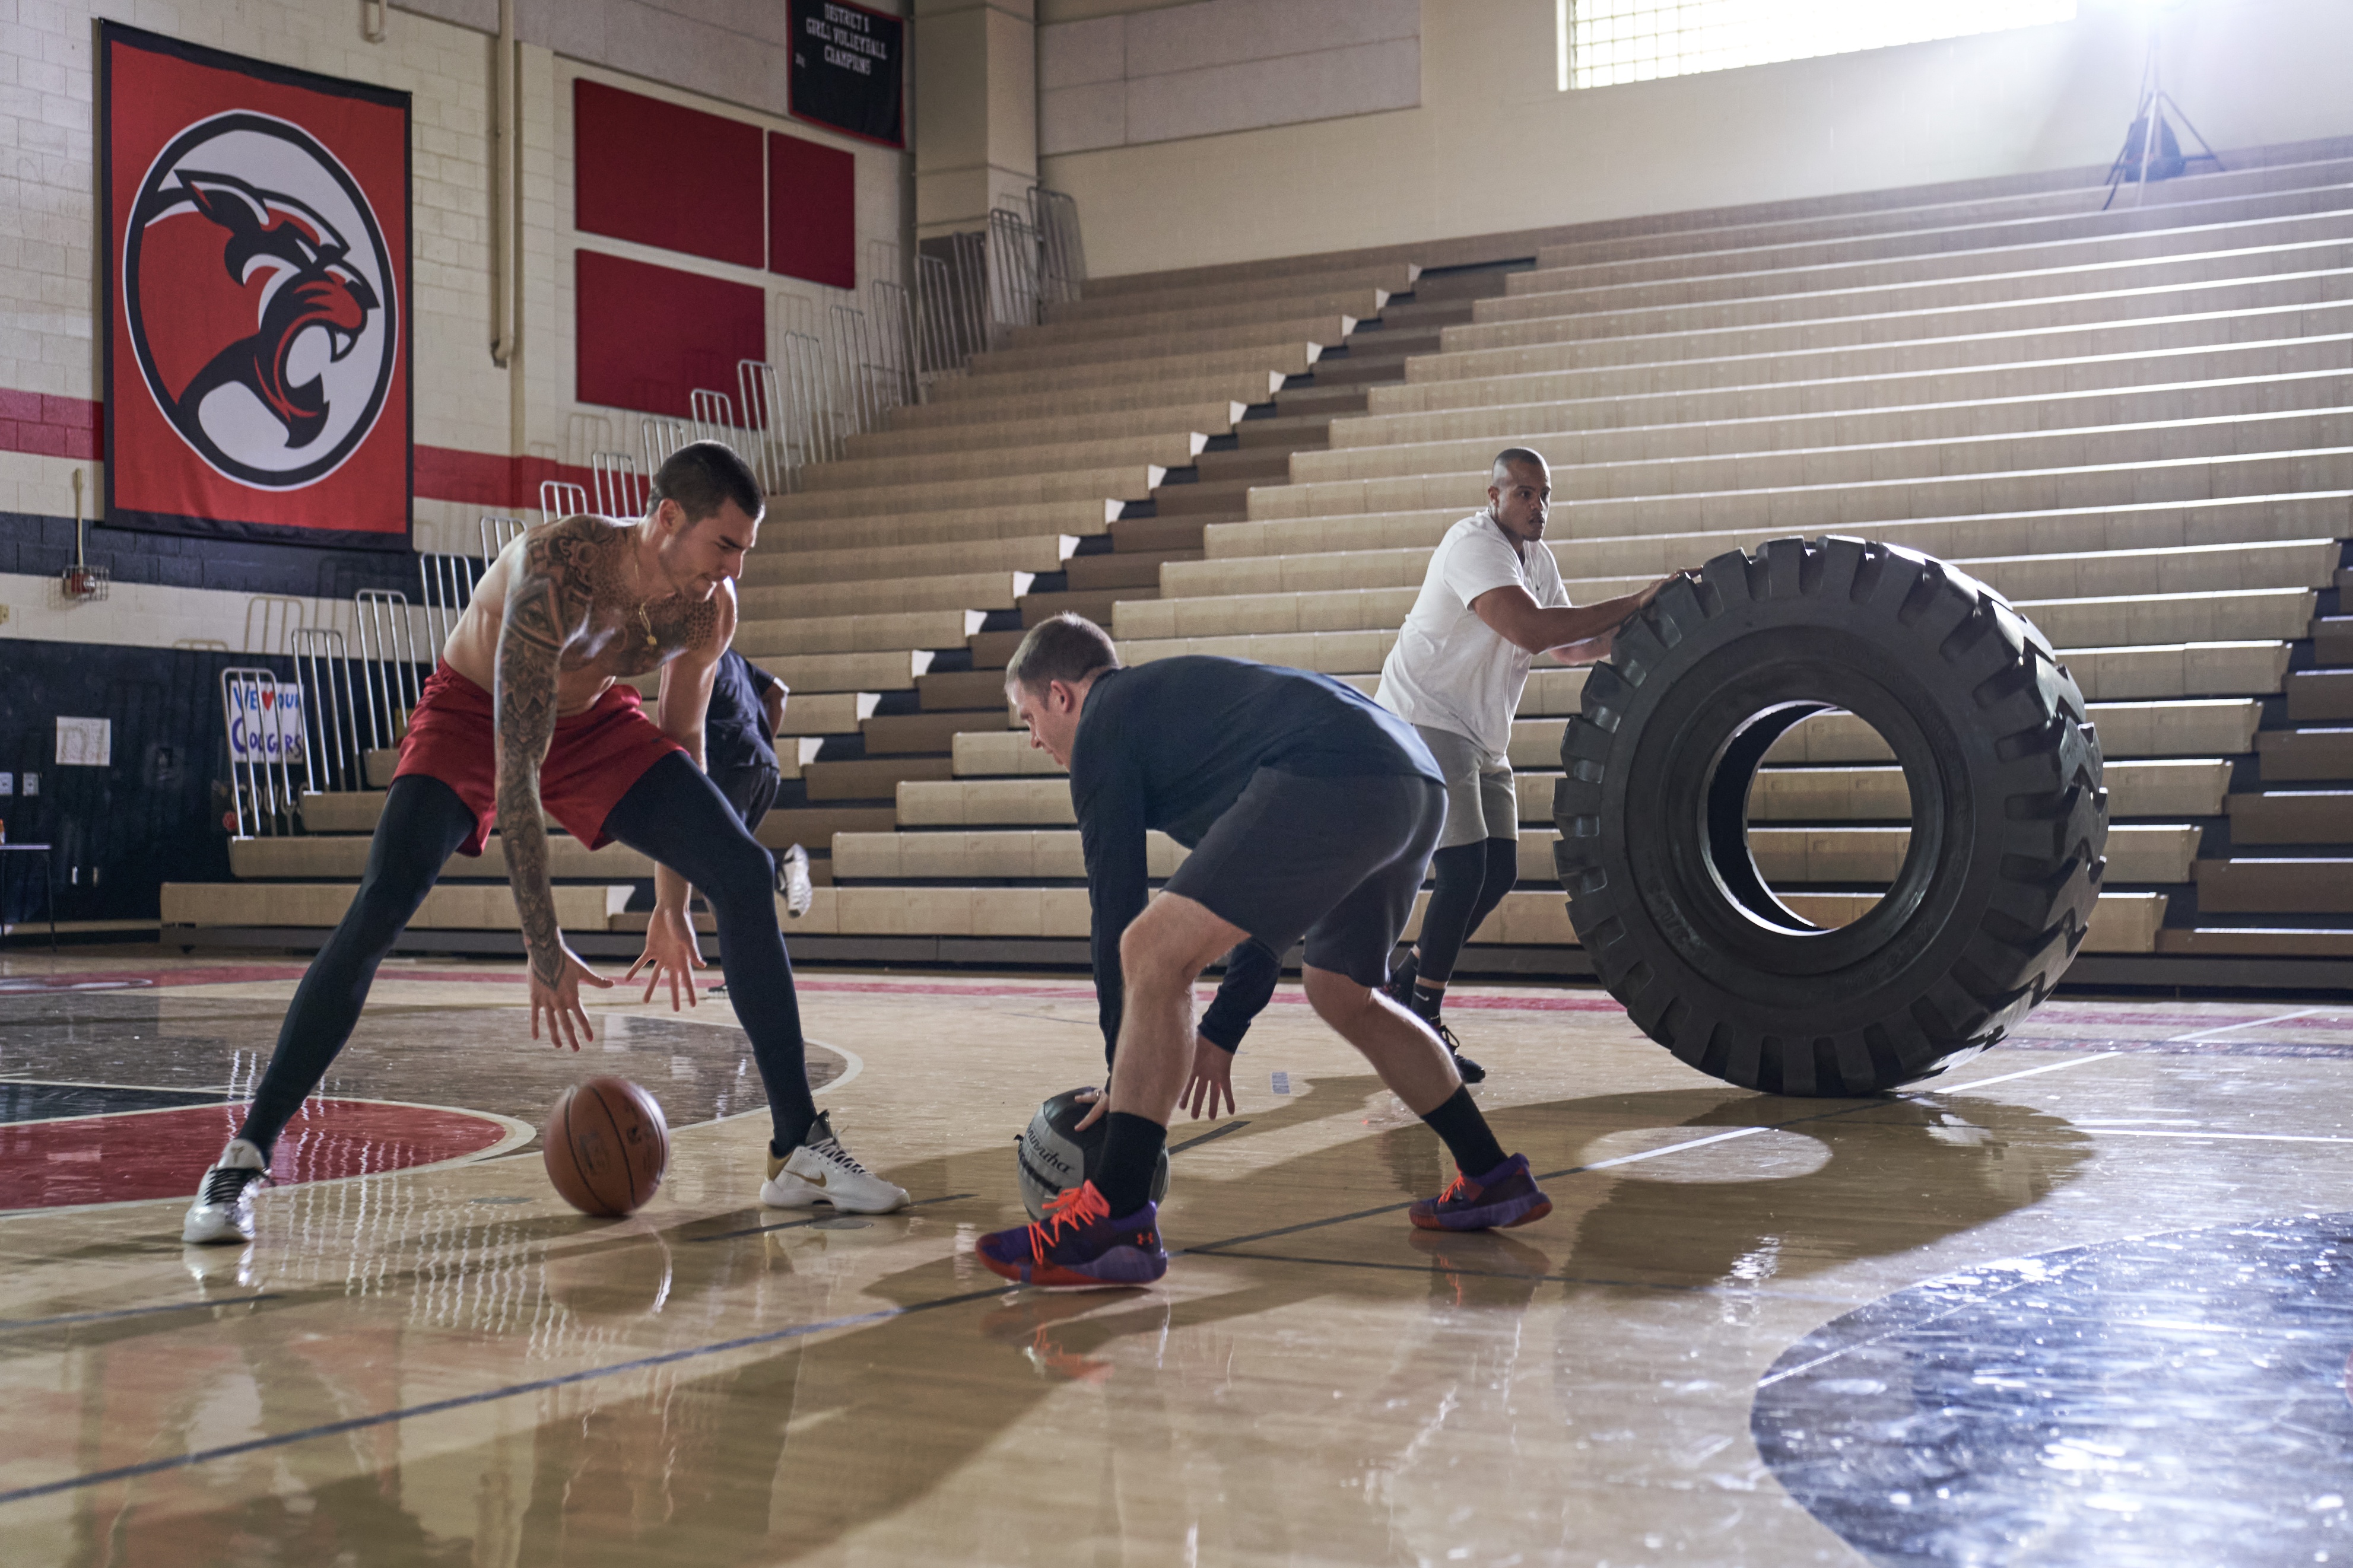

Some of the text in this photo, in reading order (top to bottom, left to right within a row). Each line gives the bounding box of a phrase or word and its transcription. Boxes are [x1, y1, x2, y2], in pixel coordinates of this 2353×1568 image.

[824, 2, 862, 31] DISTRICT
[833, 26, 887, 61] VOLLEYBALL
[824, 44, 872, 76] CHAMPIONS
